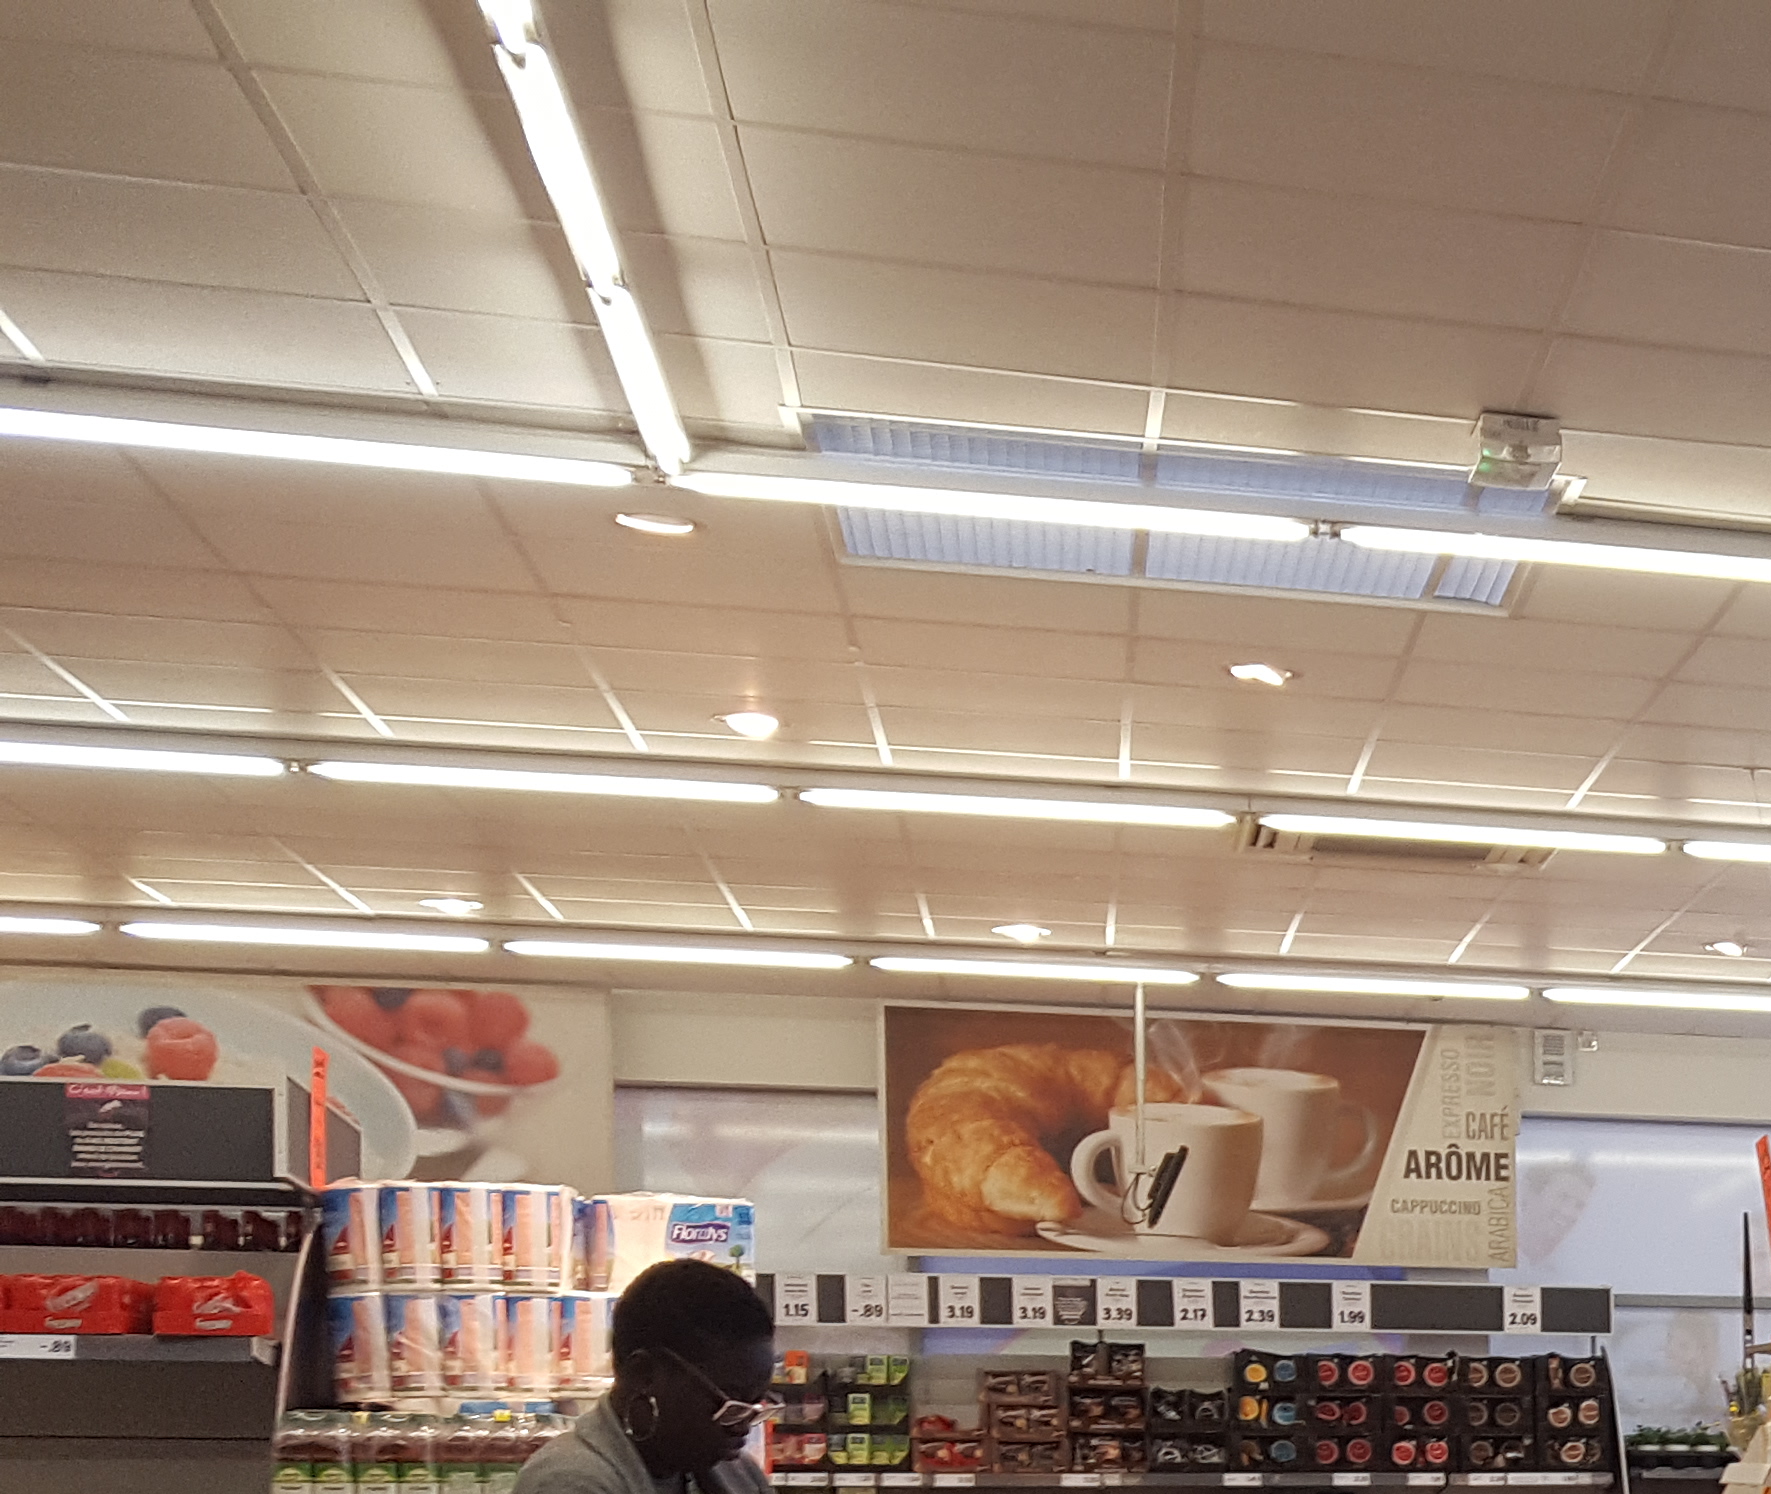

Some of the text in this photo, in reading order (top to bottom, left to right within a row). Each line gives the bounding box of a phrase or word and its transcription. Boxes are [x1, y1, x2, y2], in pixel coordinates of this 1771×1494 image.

[1464, 1105, 1510, 1142] CAFÉ
[1402, 1142, 1512, 1183] ARÔME
[1390, 1198, 1482, 1217] CAPPUCCINO
[1486, 1186, 1512, 1263] ARABICA
